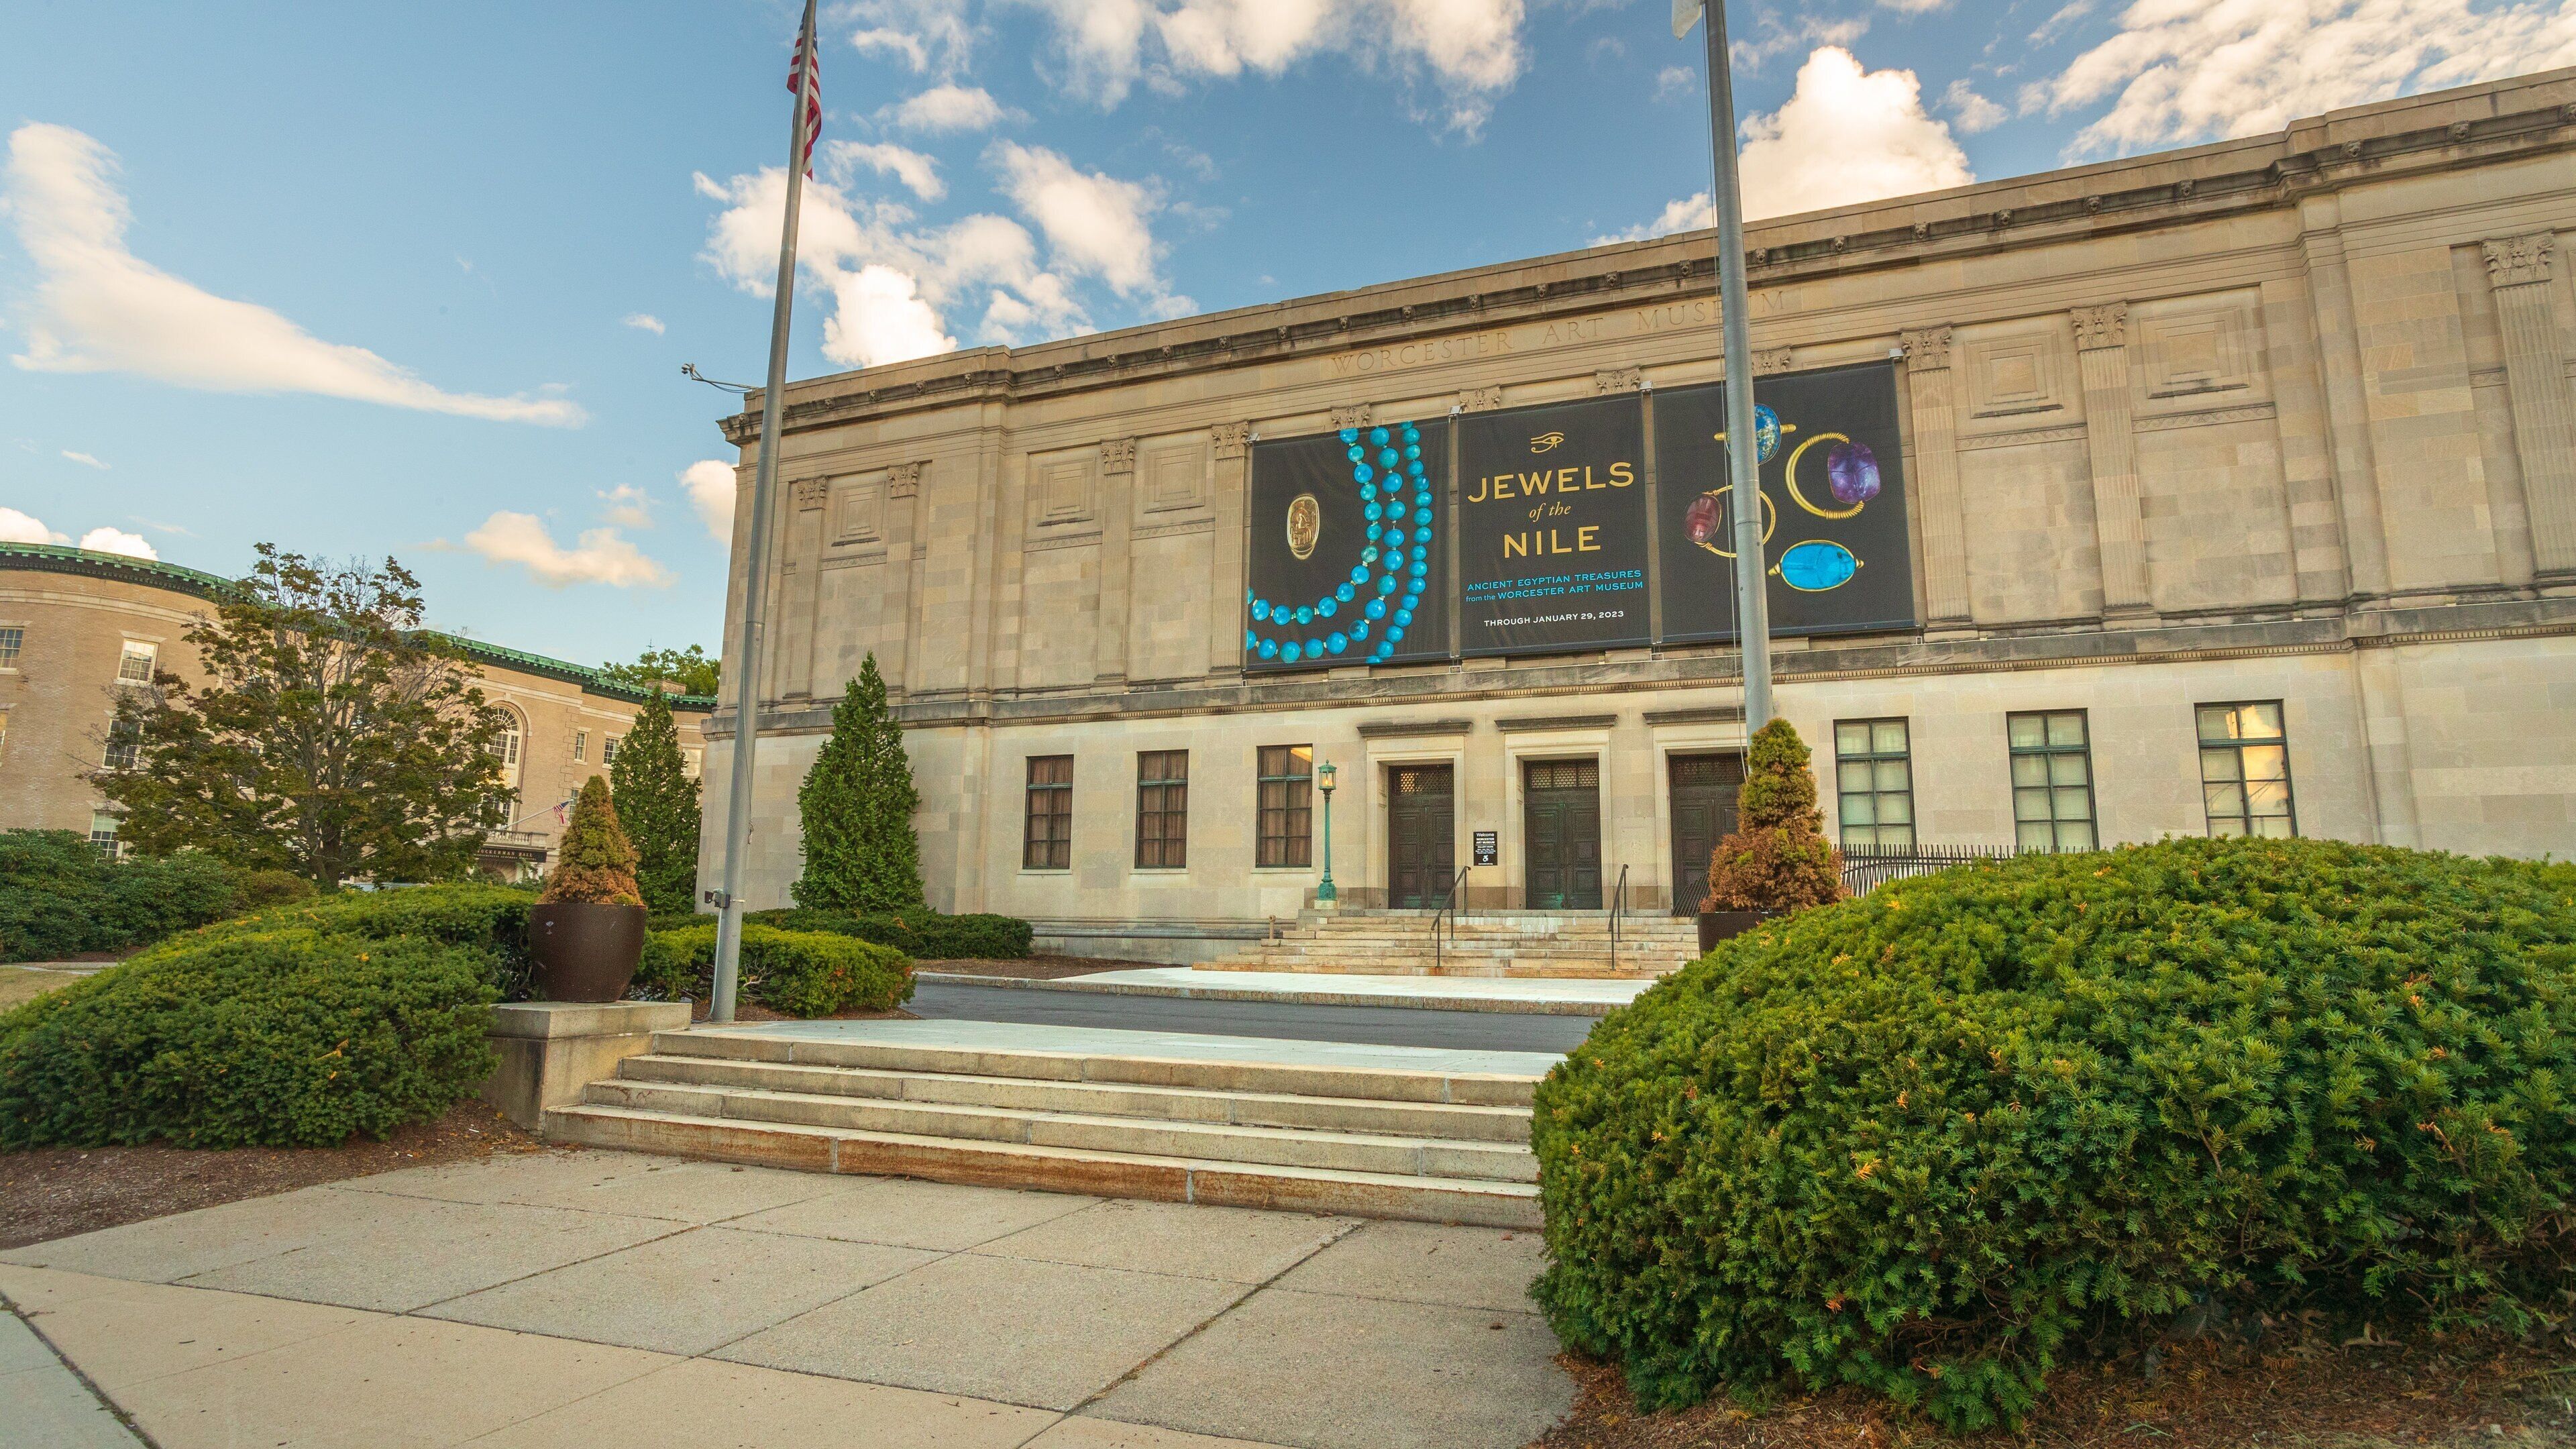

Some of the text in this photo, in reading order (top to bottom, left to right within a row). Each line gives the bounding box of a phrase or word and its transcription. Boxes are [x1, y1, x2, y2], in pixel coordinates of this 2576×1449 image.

[1331, 290, 1785, 374] WORCESTER ART MUSEM
[1467, 461, 1635, 503] JEWELS
[1529, 501, 1571, 523] of the
[1504, 525, 1601, 558] NILE
[1467, 570, 1642, 591] ANCIENT EGYPTIAN TREASURES
[1497, 587, 1564, 599] WORCESTER
[1569, 585, 1591, 594] ART
[1596, 581, 1643, 592] MUSEUM
[1484, 610, 1624, 627] THROUGH JANUARY 29, 2023
